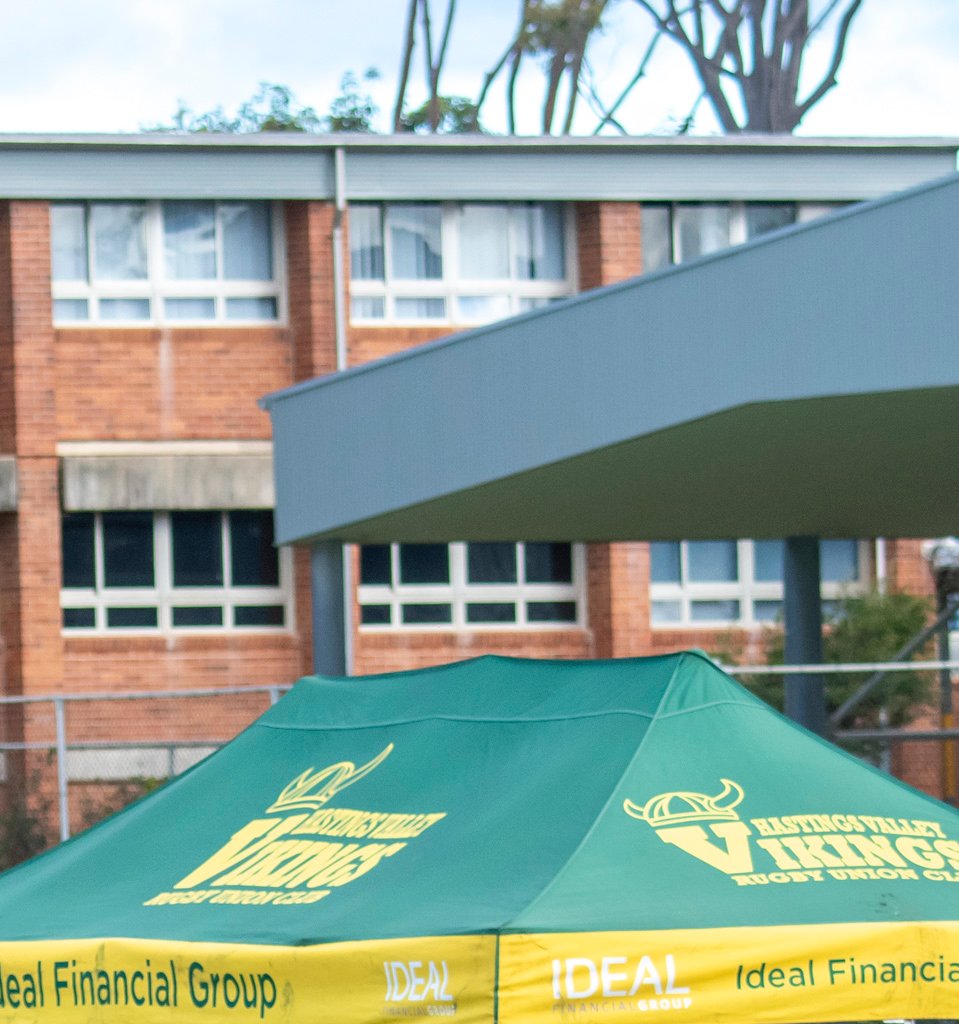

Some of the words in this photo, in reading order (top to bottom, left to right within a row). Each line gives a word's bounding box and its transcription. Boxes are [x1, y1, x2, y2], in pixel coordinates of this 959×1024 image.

[750, 814, 866, 836] HASTINGS
[858, 815, 947, 839] VALLEY
[173, 813, 408, 889] VIKINGS
[655, 821, 959, 875] VIKINGS
[731, 870, 824, 886] RUGBY
[827, 868, 920, 880] UNION
[923, 870, 959, 882] CL
[53, 959, 178, 1008] Financial
[188, 962, 277, 1018] Group
[383, 960, 453, 1001] IDEAL
[551, 954, 690, 1000] IDEAL
[736, 959, 815, 990] Ideal
[828, 955, 959, 985] Financia
[552, 1000, 637, 1014] FINANCIAL
[637, 998, 692, 1011] GROUP
